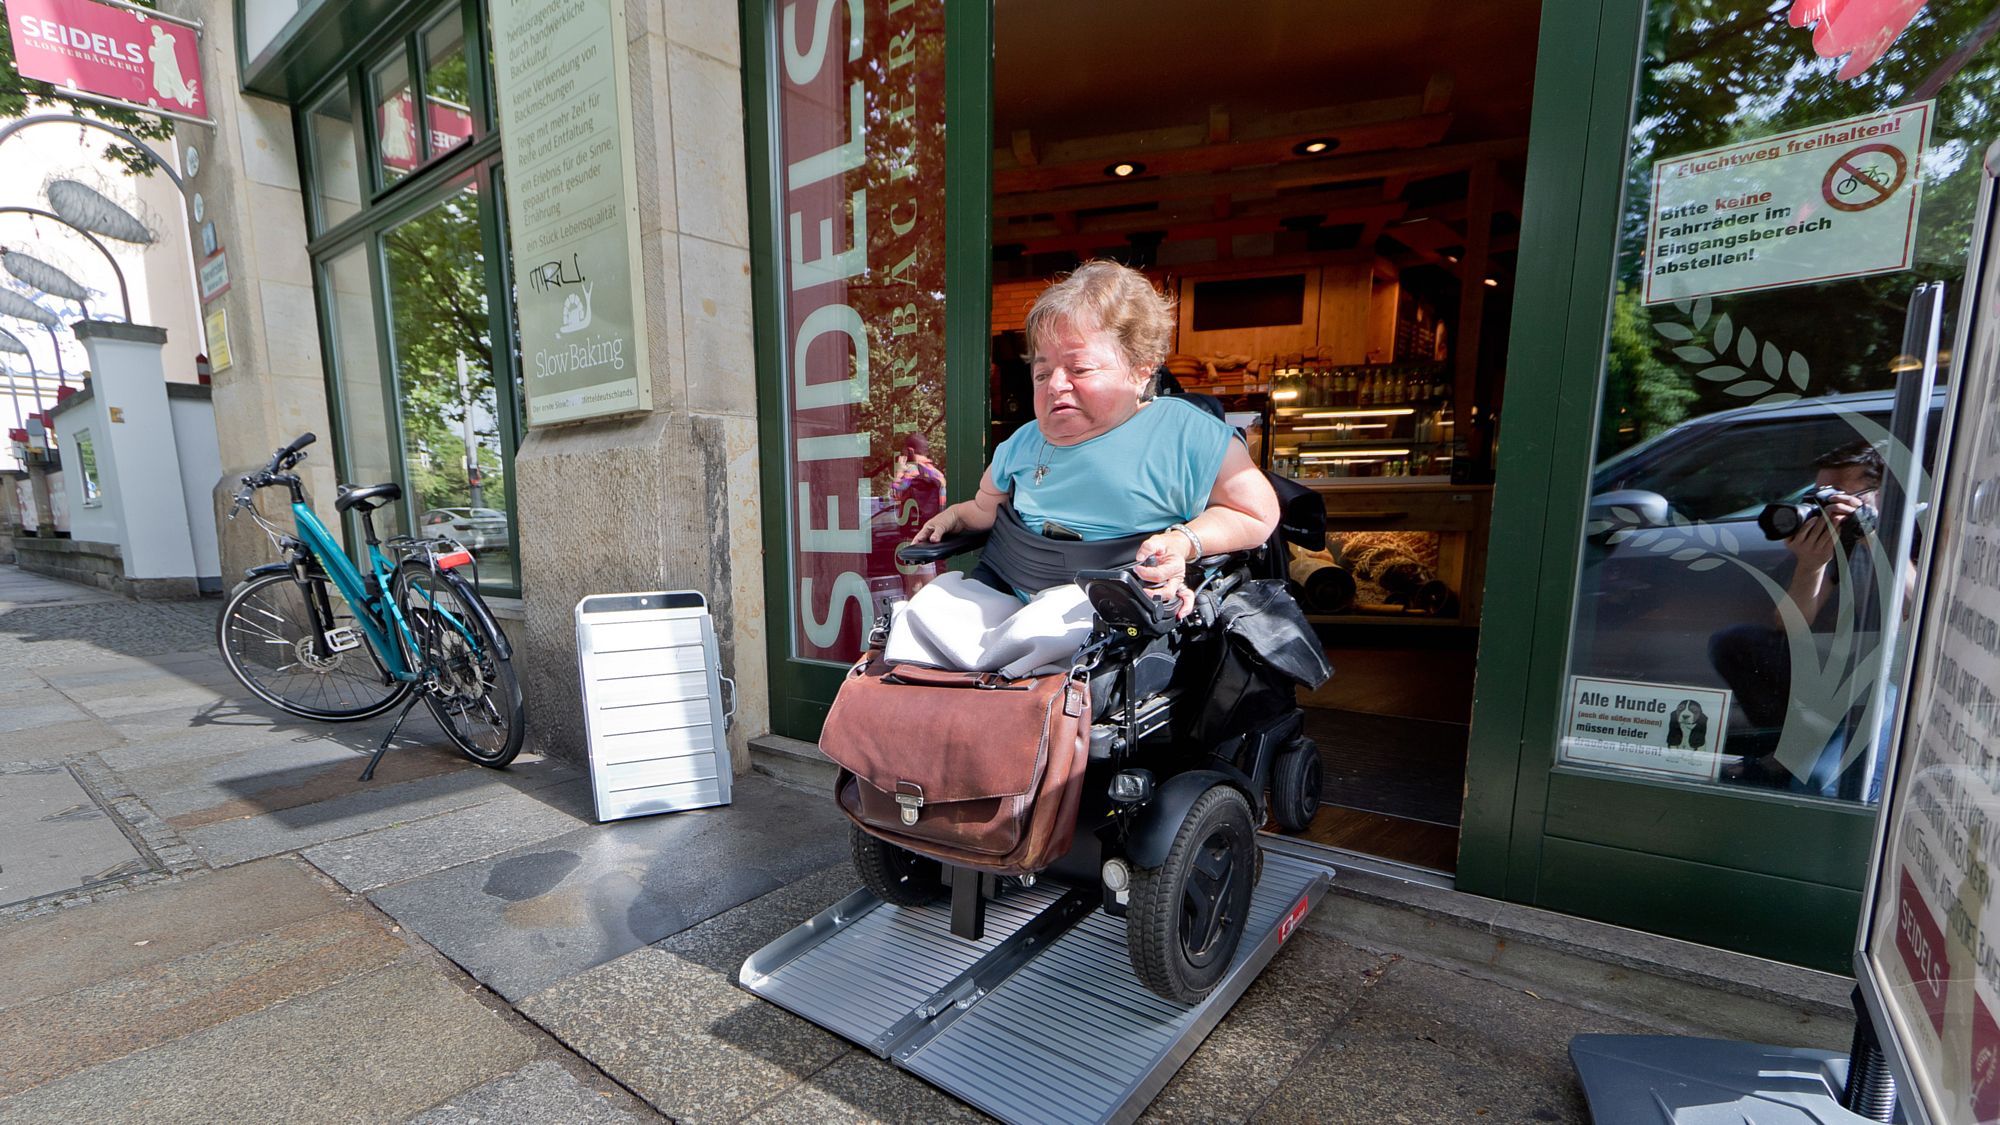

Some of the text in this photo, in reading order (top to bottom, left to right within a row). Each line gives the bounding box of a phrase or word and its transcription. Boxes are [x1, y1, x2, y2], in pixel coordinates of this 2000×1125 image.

[20, 15, 144, 64] SEIDELS
[509, 1, 585, 61] durch handwerkliche
[510, 46, 549, 79] Backkultur
[512, 44, 597, 105] keine Verwendung von
[514, 79, 575, 123] Backmischungen
[517, 94, 601, 150] Teige mit mehr Zeit für
[518, 118, 594, 167] Reife und Entfaltung
[520, 137, 614, 193] ein Erlebnis für die Sinne,
[1677, 118, 1901, 176] Fluchtweg freihalten!
[522, 163, 602, 211] gepaart mit gesunder
[1660, 190, 1772, 221] Bitte keine
[524, 202, 561, 227] Ernährung
[526, 205, 617, 252] ein Stück Lebensqualität
[1657, 217, 1832, 258] Eingangsbereich
[1659, 205, 1791, 239] Fahrräder im
[1655, 249, 1755, 276] abstellen!
[783, 0, 874, 652] SEIDELS
[1579, 691, 1667, 713] Alle Hunde
[1576, 723, 1648, 739] müssen leider
[1901, 898, 1941, 1000] SEIDELS
